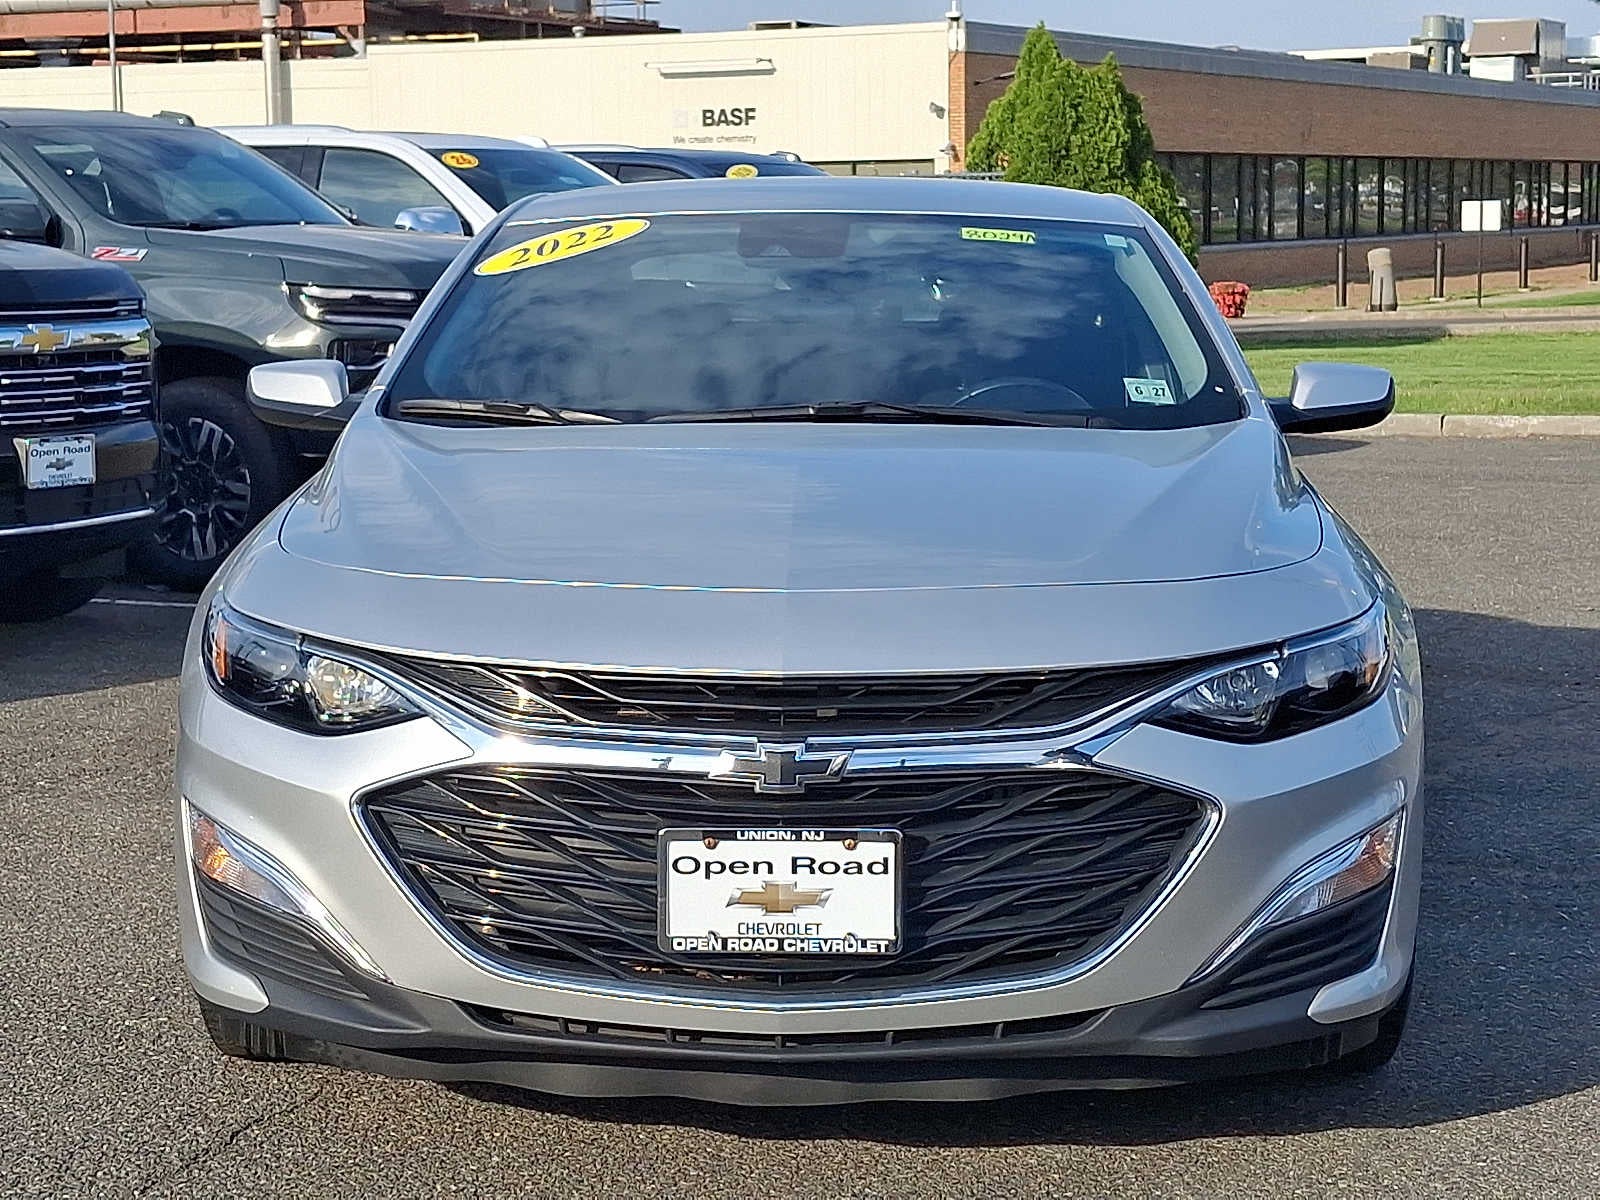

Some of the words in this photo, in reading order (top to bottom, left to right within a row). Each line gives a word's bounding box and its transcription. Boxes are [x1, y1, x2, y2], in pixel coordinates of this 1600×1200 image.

[702, 108, 756, 127] BASF
[672, 136, 686, 144] We
[509, 225, 614, 267] 2022
[1152, 387, 1166, 397] 27
[31, 448, 59, 459] Open
[63, 445, 91, 455] Road
[736, 830, 797, 841] UNION,
[801, 830, 825, 841] NJ
[672, 856, 774, 880] Open
[791, 856, 889, 875] Road
[737, 923, 823, 936] CHEVROLET
[672, 938, 723, 952] OPEN
[727, 938, 778, 952] ROAD
[783, 938, 889, 953] CHEVROLET
